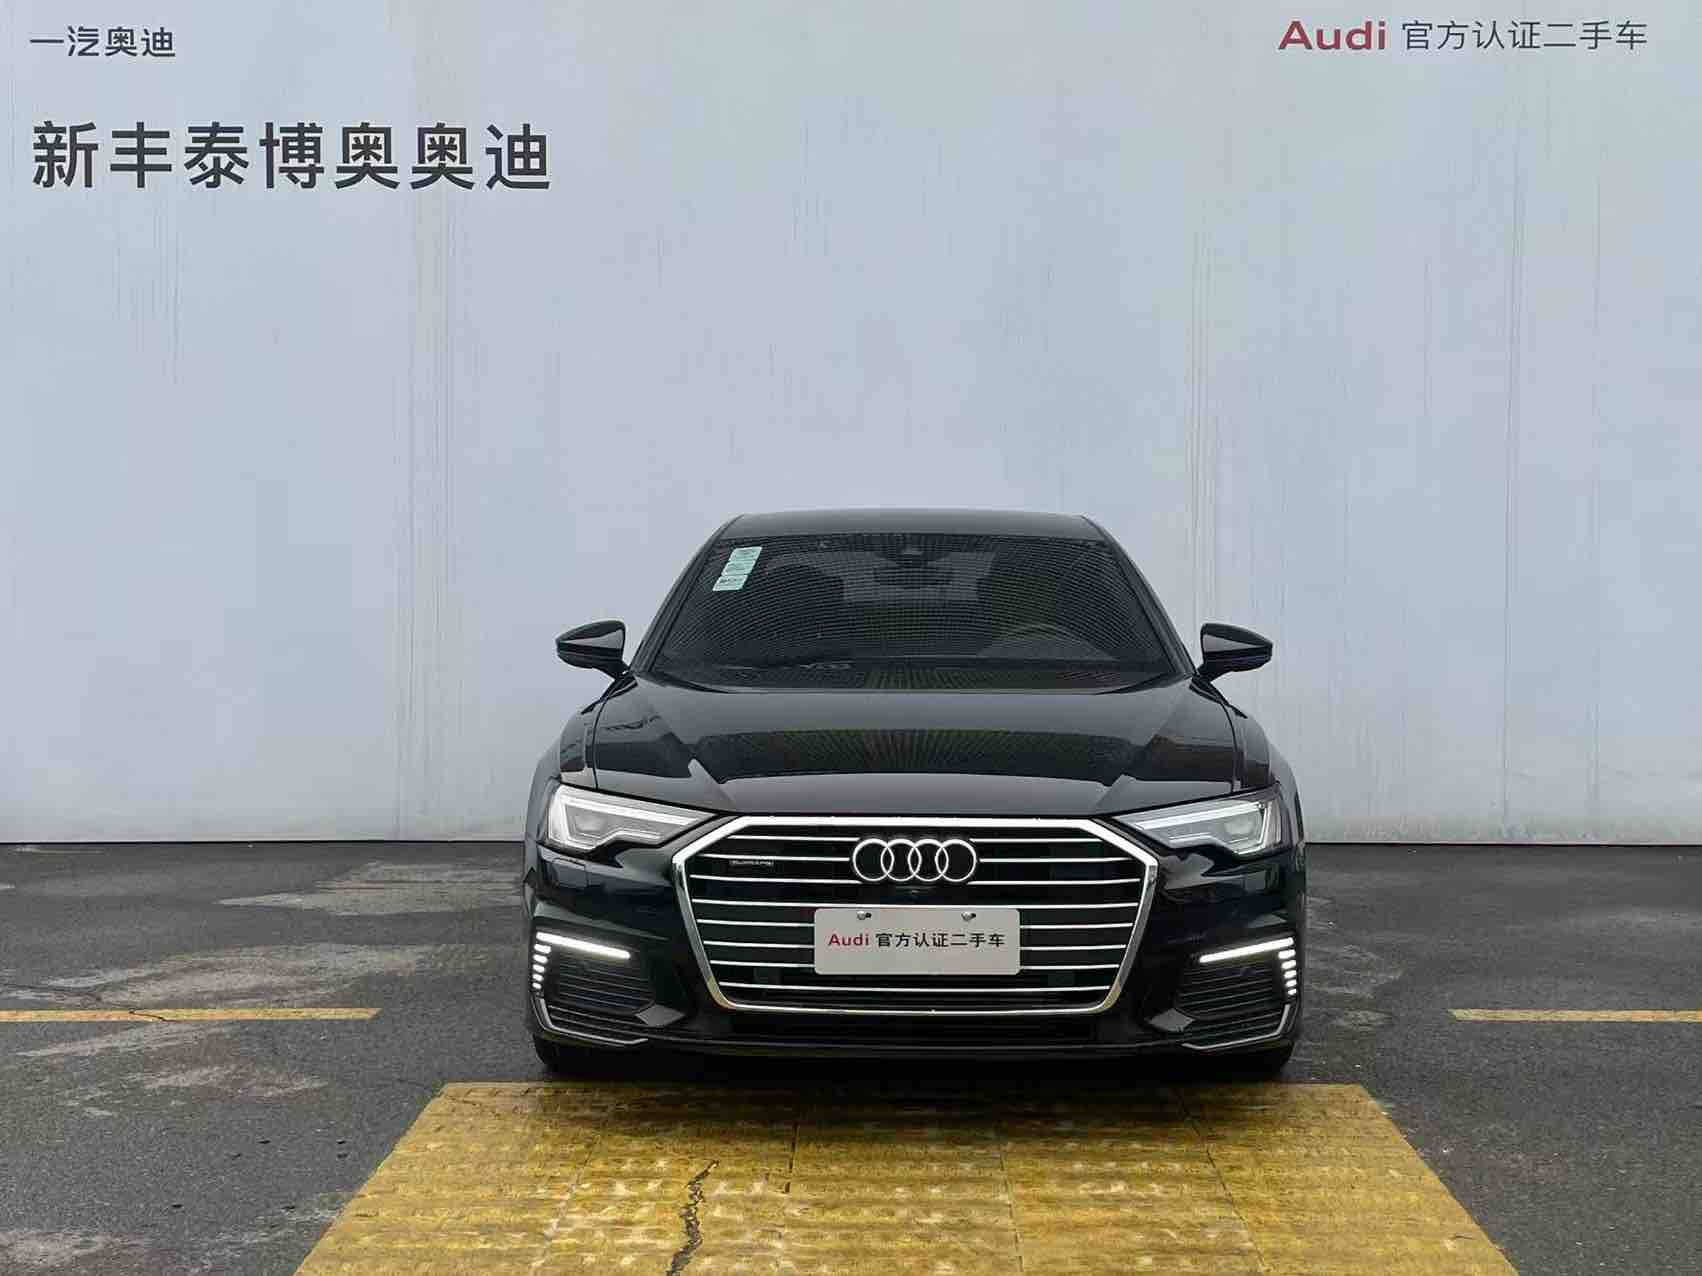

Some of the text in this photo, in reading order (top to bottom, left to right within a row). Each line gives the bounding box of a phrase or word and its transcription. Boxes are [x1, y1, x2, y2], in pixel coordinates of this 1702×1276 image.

[29, 25, 176, 58] 一汽奥迪
[1277, 19, 1649, 51] Audi 官方认证二手车
[31, 120, 552, 191] 新丰泰博奥奥迪
[827, 932, 1006, 948] Audi 官方认证二手车
